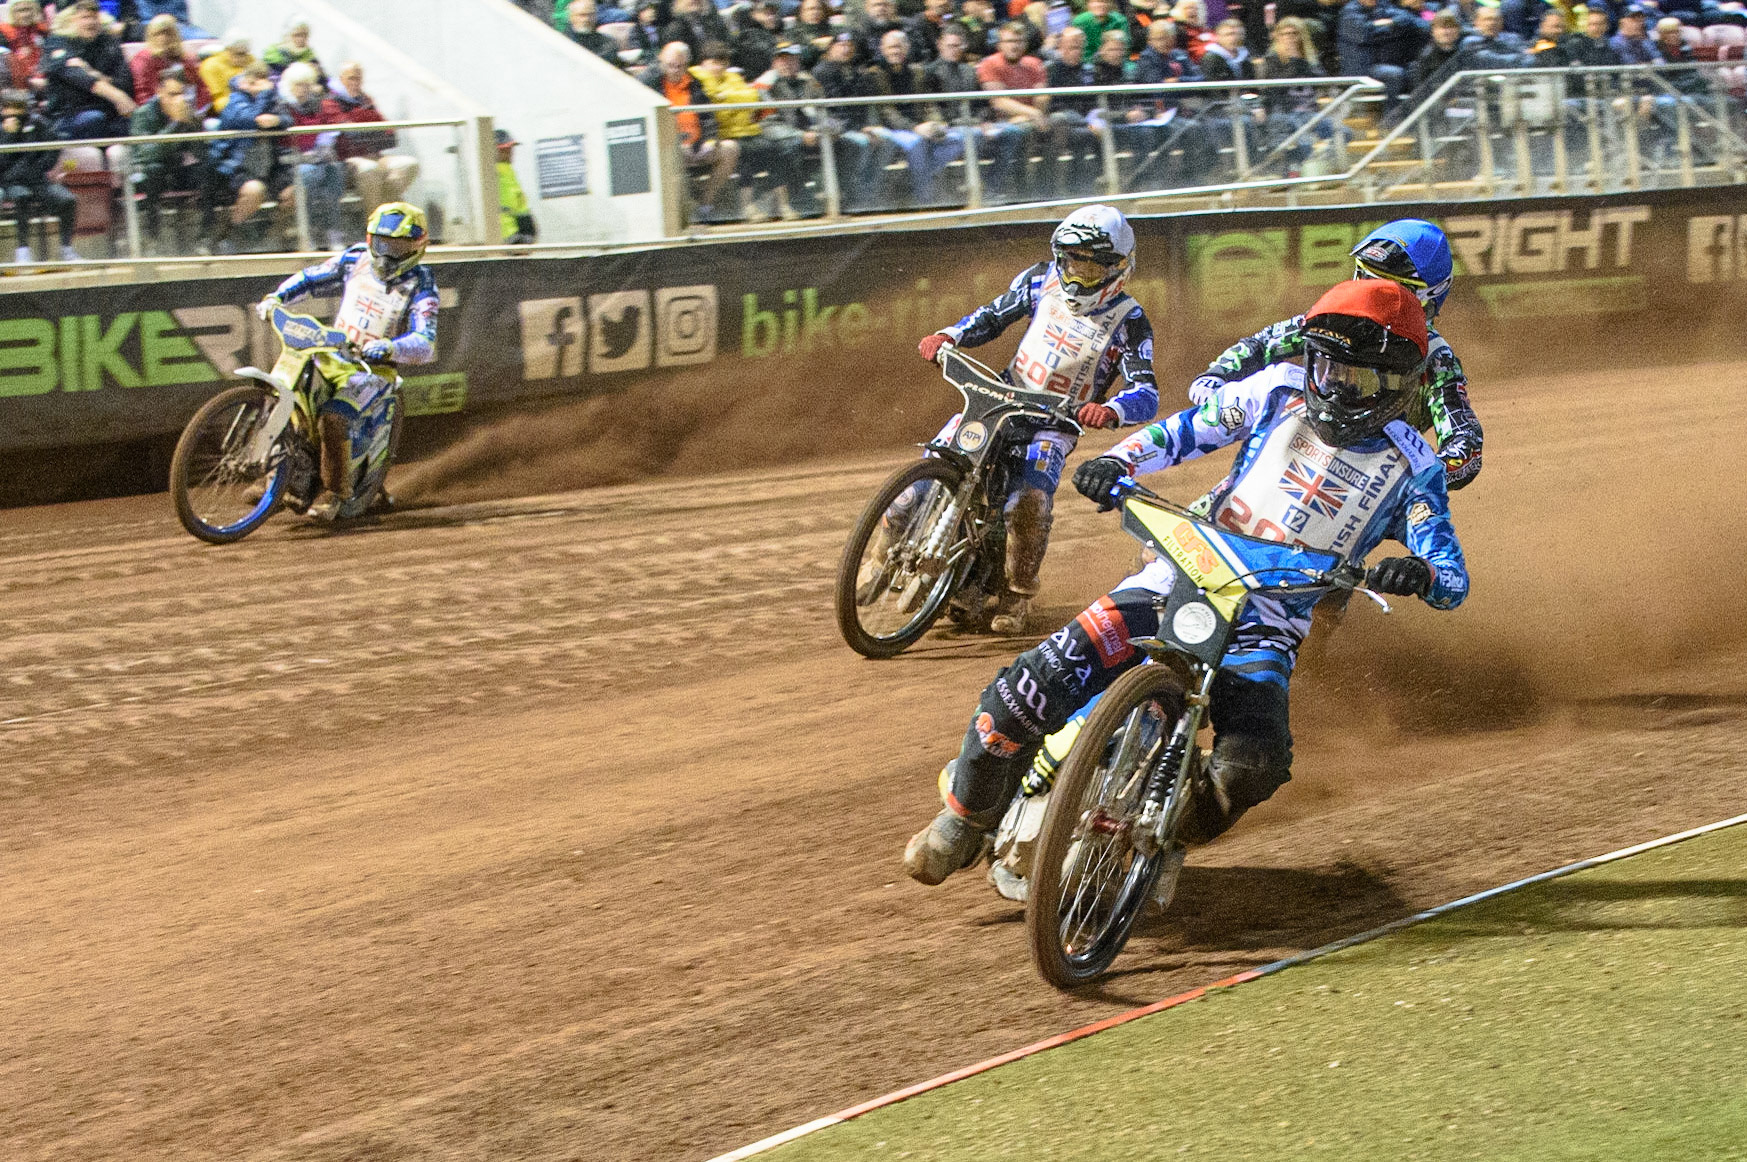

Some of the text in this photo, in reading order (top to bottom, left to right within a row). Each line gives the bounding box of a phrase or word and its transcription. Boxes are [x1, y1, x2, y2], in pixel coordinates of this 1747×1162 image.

[1302, 205, 1652, 288] BRIGHT
[1091, 312, 1117, 353] FINAL
[1292, 436, 1369, 489] SPORTS INSURE
[1358, 453, 1401, 511] FINAL
[1287, 508, 1308, 532] 12
[1162, 535, 1204, 583] FILTRATION
